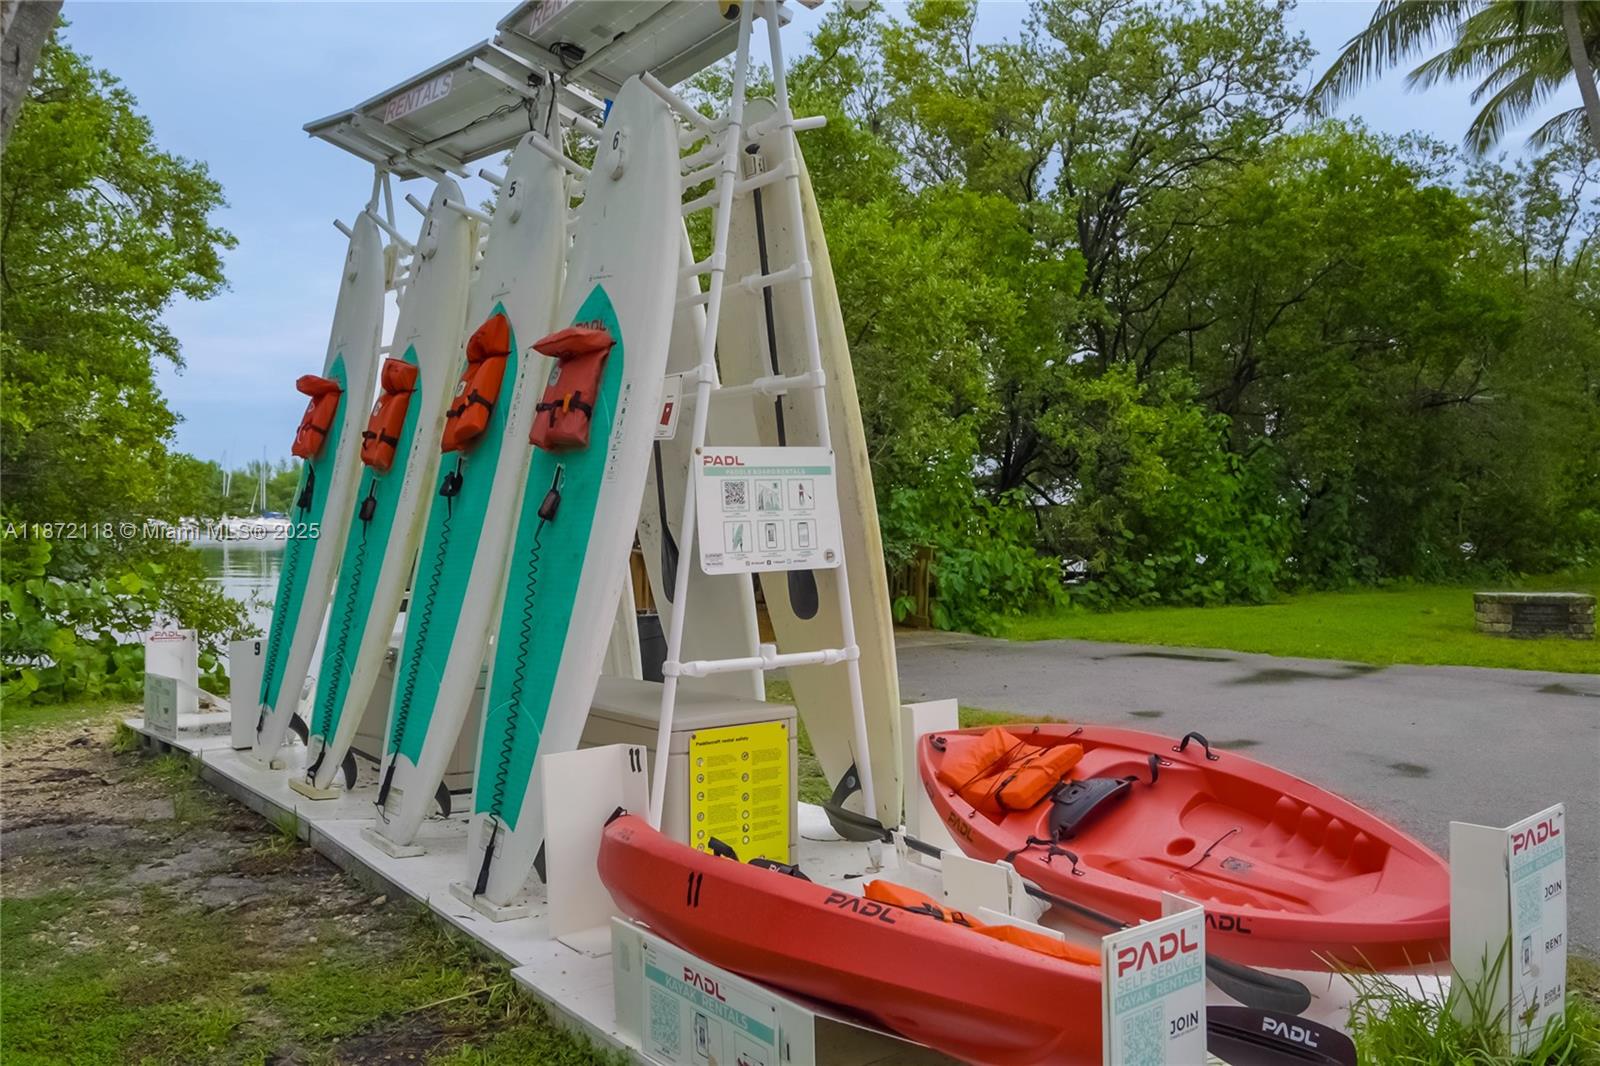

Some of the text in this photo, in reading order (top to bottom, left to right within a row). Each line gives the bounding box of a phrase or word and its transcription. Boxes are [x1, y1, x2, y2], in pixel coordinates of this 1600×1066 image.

[386, 74, 451, 121] RENTALS
[612, 130, 620, 150] 6
[508, 180, 517, 198] 5
[703, 455, 745, 466] PADL
[254, 641, 261, 656] 9
[628, 747, 642, 773] 11
[947, 811, 974, 843] PADL
[1512, 818, 1560, 856] PADL
[686, 871, 703, 908] 11
[1544, 880, 1562, 898] JOIN
[823, 892, 897, 925] PADL
[1205, 914, 1252, 934] ADL
[1117, 927, 1198, 978] PADL
[1545, 933, 1562, 951] RENT
[1150, 953, 1200, 981] SERVICE
[683, 966, 726, 1002] PADL
[664, 975, 749, 1030] KAYAK RENTALS
[1170, 1010, 1199, 1035] JOIN
[1262, 1016, 1318, 1048] PADL
